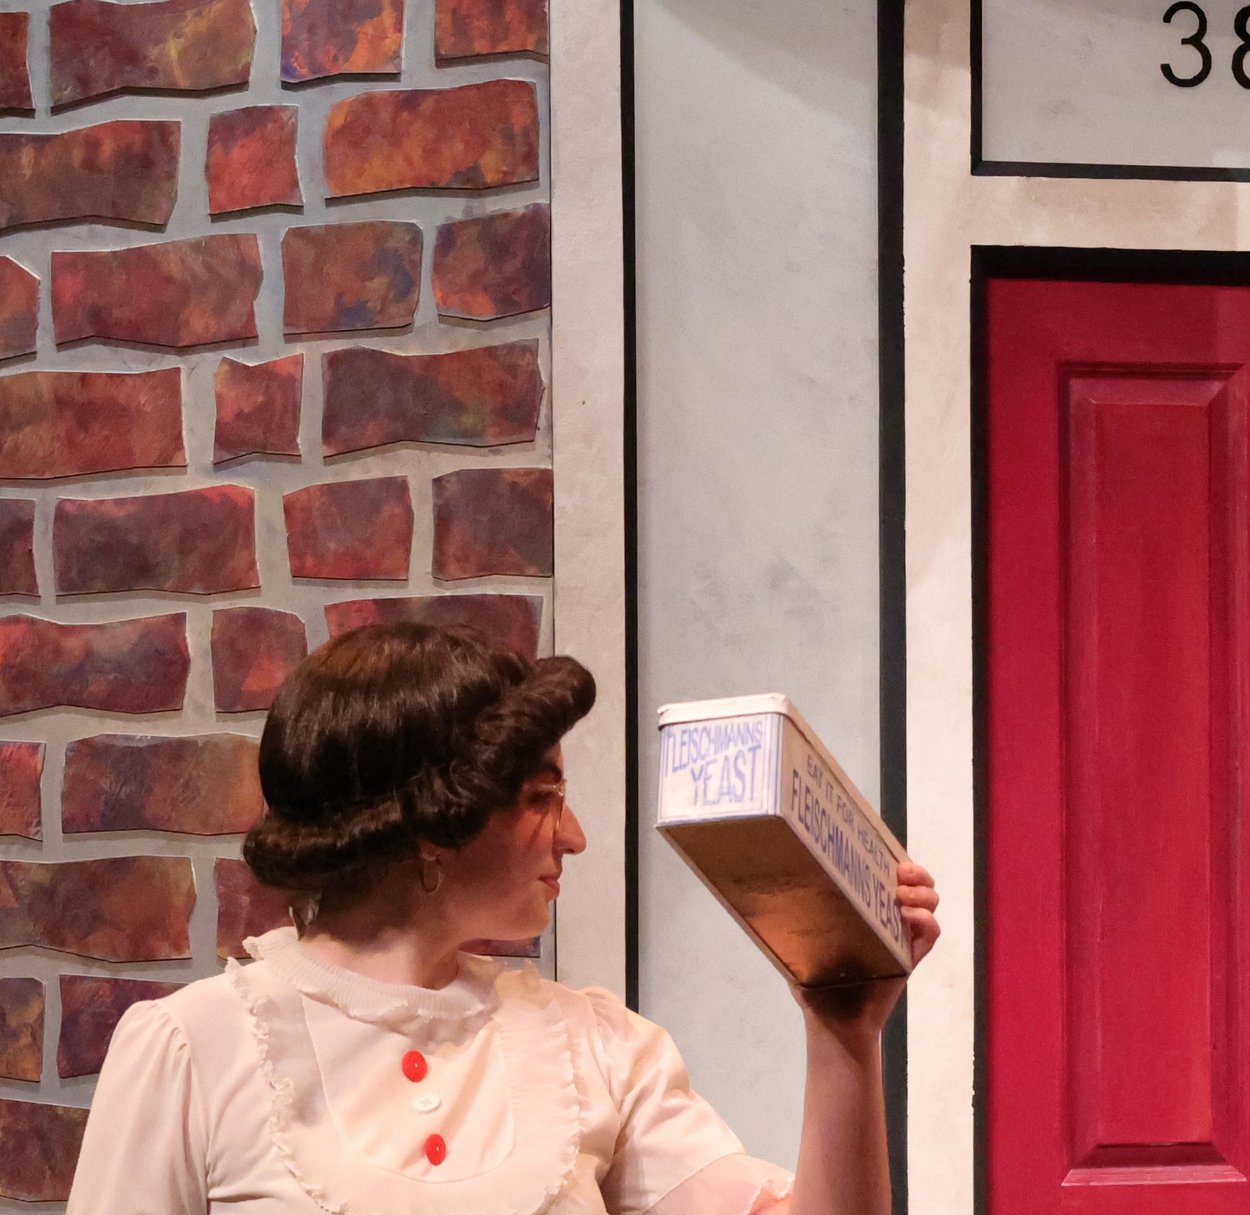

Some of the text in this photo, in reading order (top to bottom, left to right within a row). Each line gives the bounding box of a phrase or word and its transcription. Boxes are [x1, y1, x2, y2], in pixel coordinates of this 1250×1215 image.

[690, 744, 762, 807] YEAST
[807, 753, 890, 878] EAT IT FOR HEALTH
